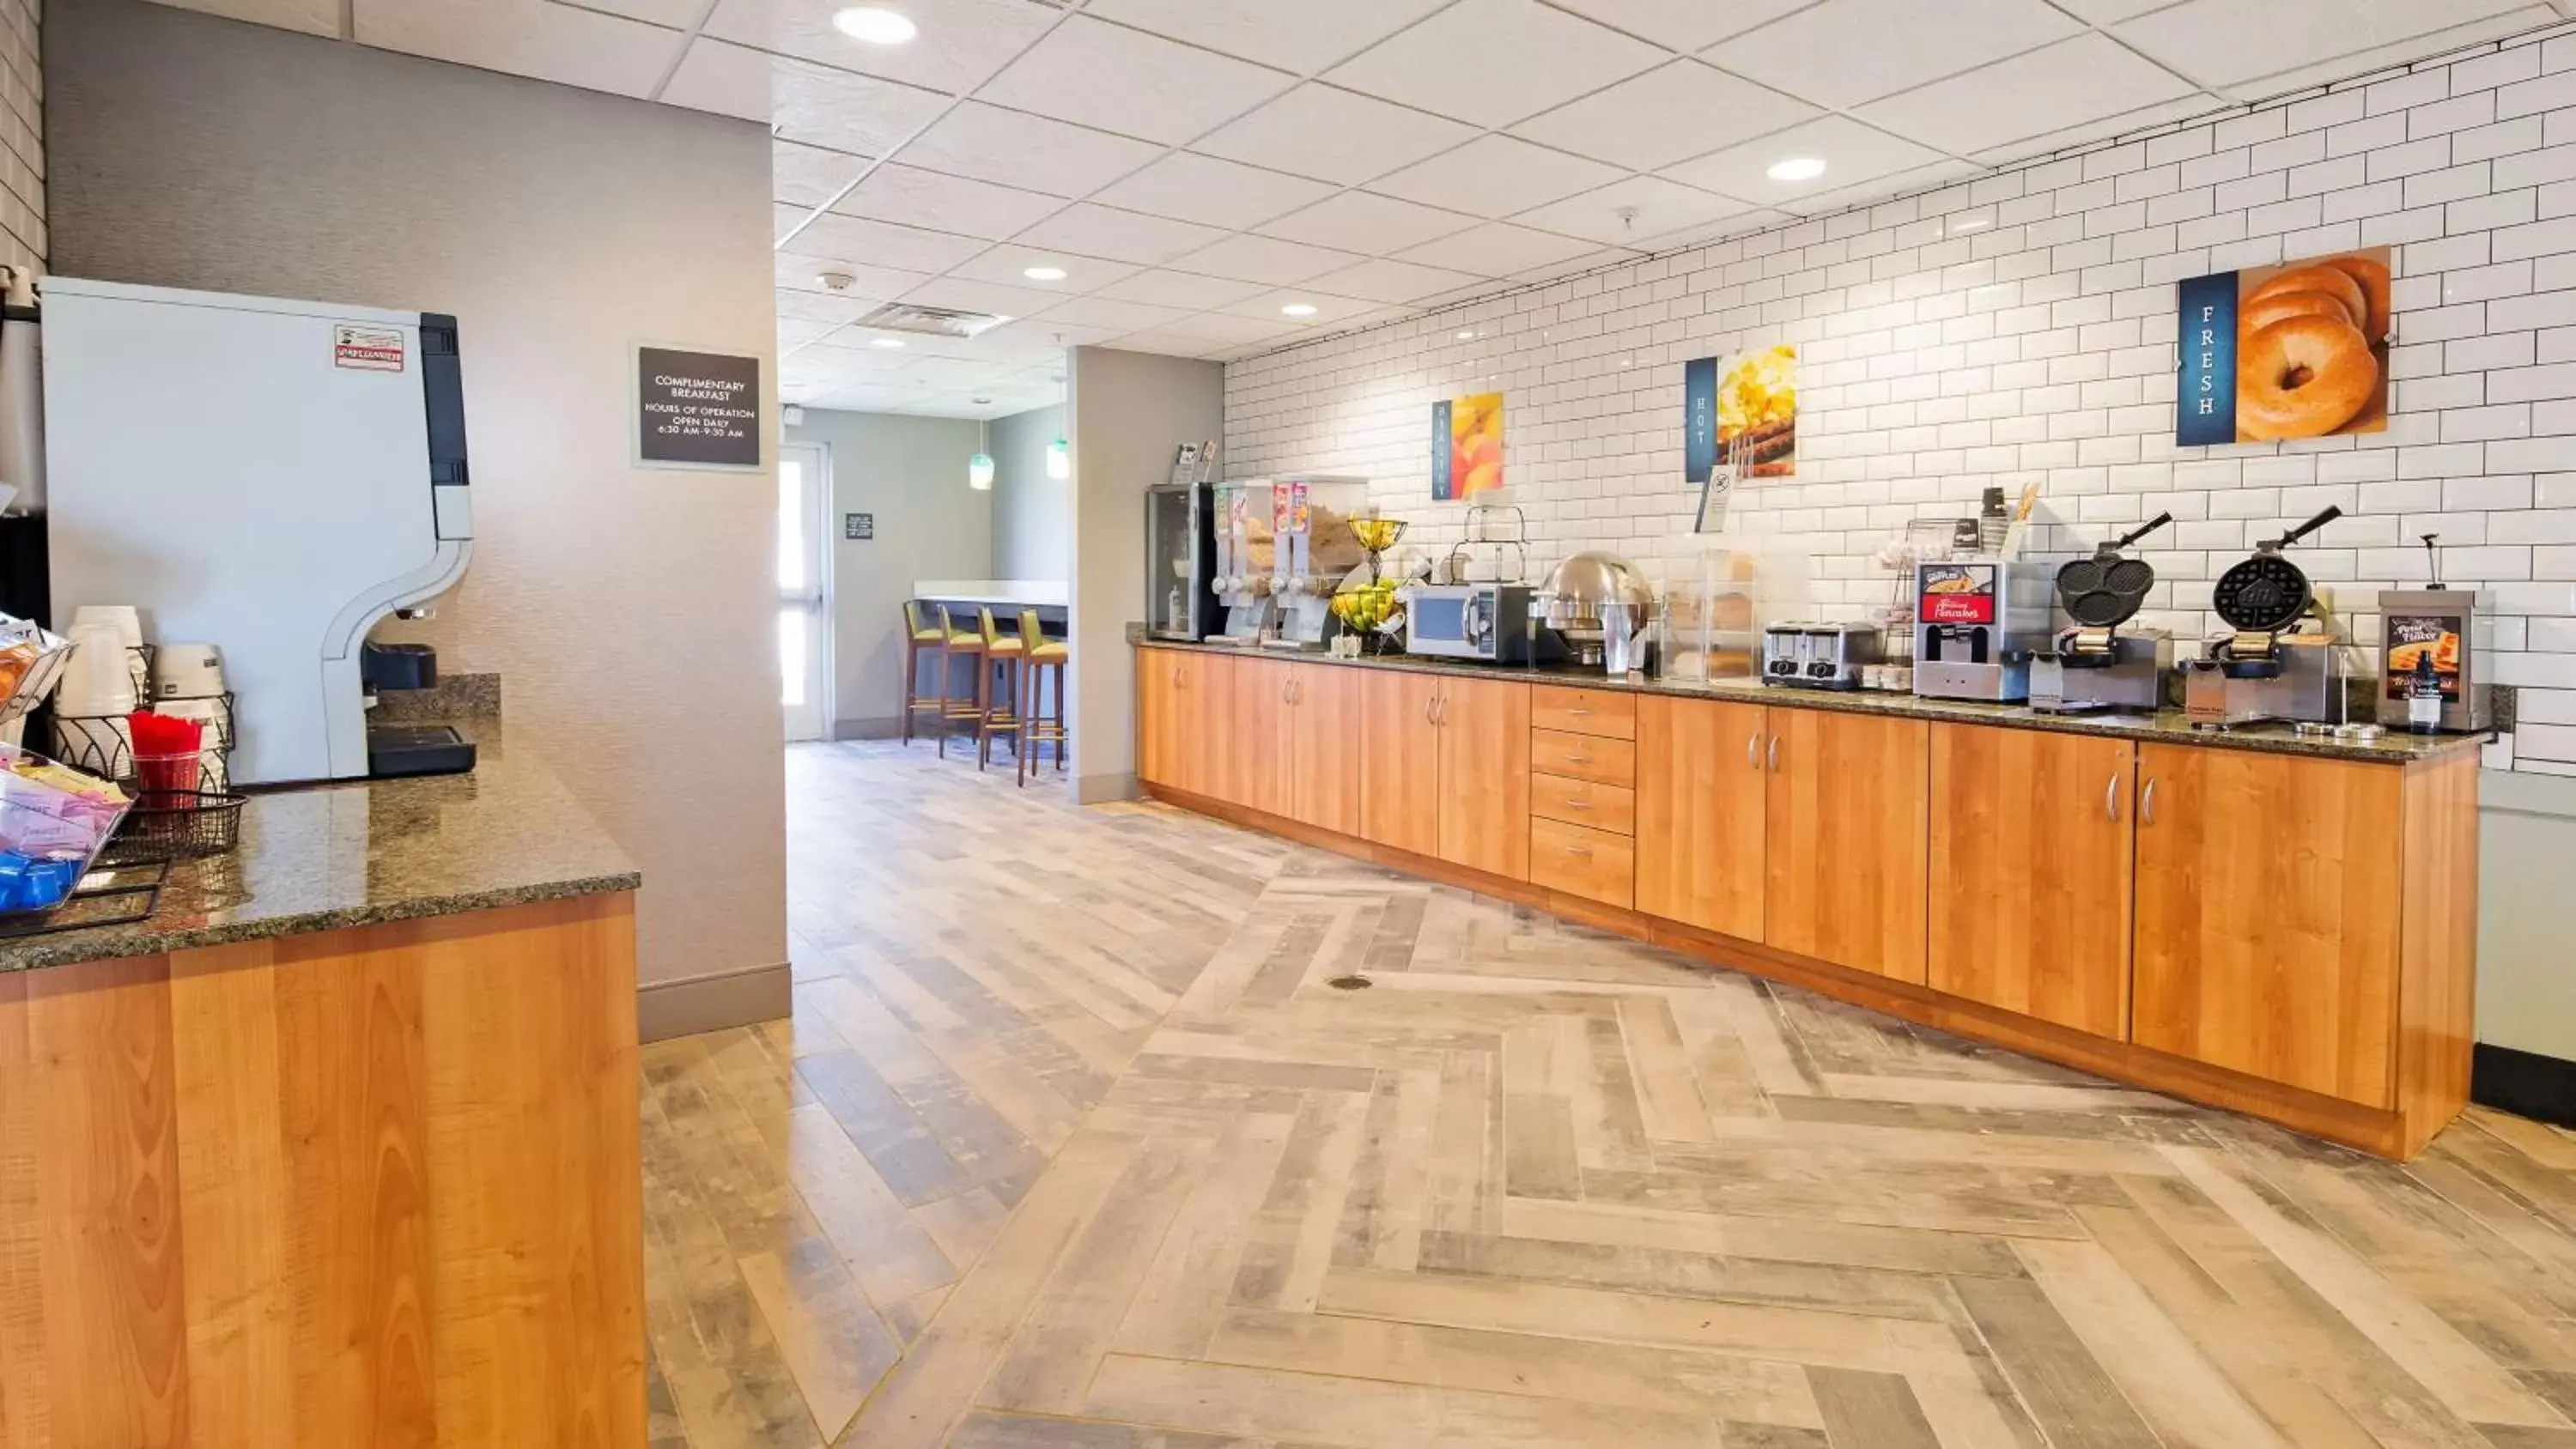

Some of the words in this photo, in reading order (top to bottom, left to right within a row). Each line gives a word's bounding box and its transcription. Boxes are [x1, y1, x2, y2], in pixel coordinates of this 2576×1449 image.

[2198, 306, 2215, 415] FRESH
[655, 375, 745, 391] COMPLIMENTARY
[671, 387, 730, 401] BREAKFAST
[645, 403, 680, 413] HOURS
[683, 406, 697, 415] OF
[700, 407, 755, 419] OPERATION
[672, 416, 700, 427] OPEN
[703, 418, 730, 428] DAILY
[1697, 397, 1706, 445] HOT
